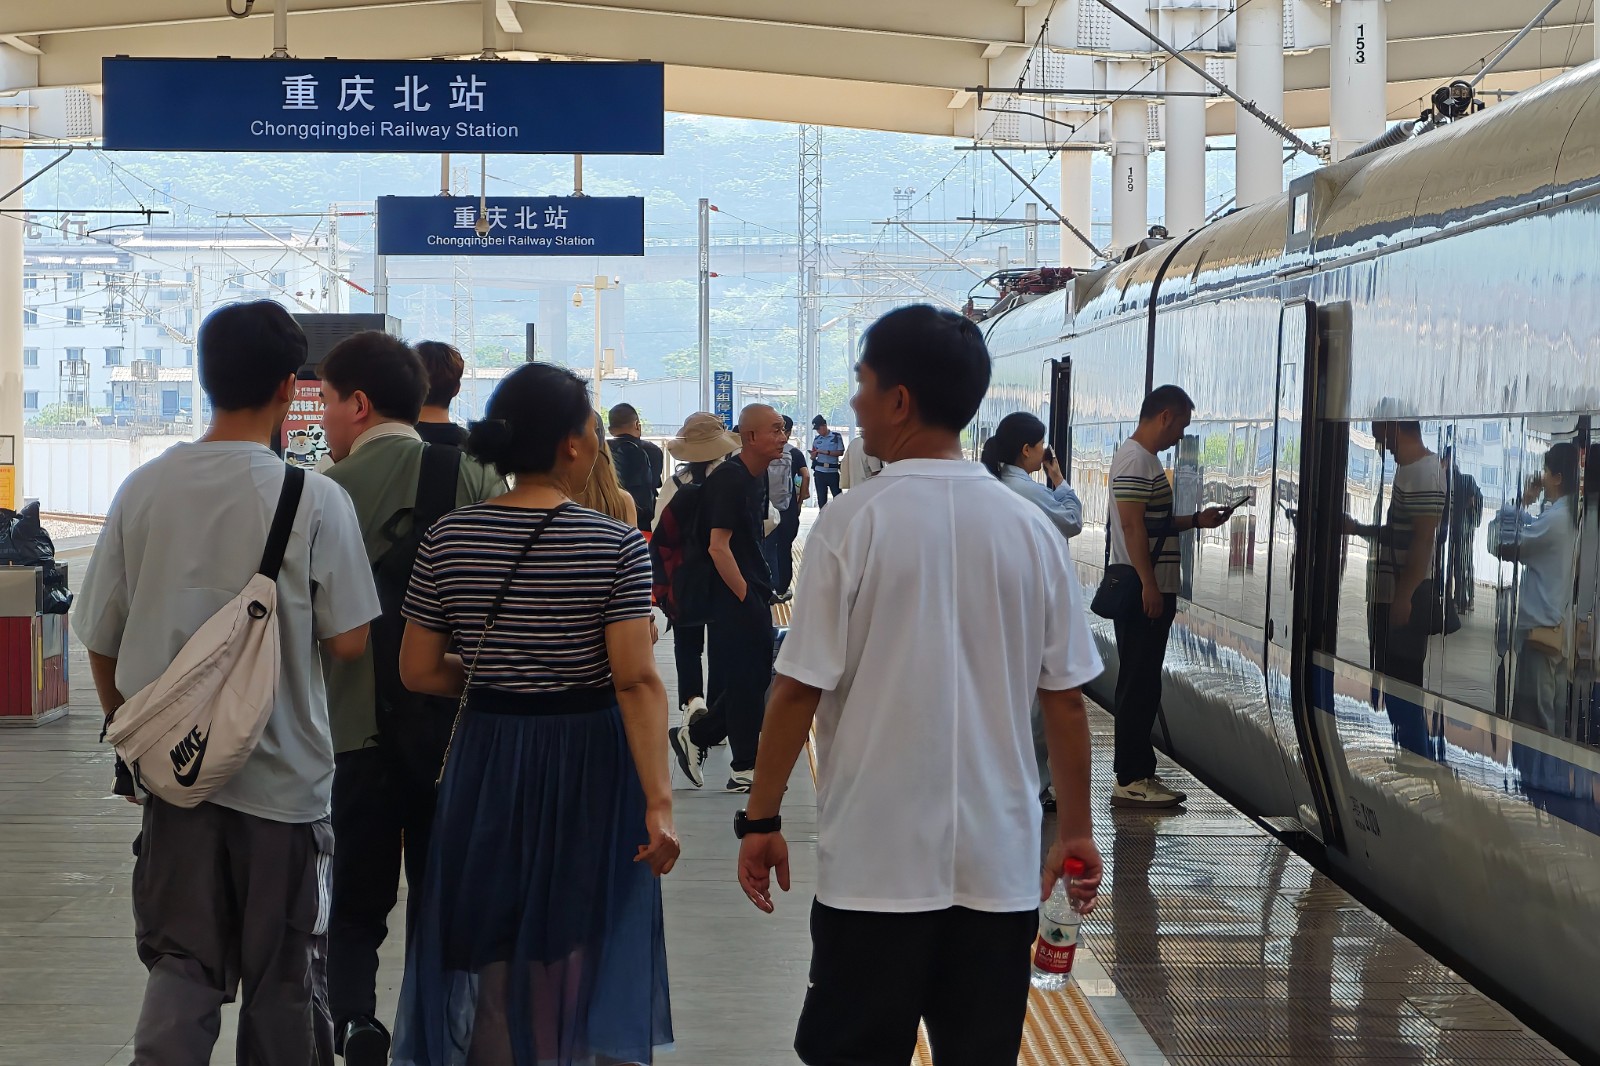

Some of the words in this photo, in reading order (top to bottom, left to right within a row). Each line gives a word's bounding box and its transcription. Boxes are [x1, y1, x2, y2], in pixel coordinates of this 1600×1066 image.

[1355, 24, 1365, 63] 153
[281, 74, 487, 112] 重庆北站
[250, 120, 375, 140] Chongqingbei
[380, 121, 451, 140] Railway
[455, 122, 519, 138] Station
[453, 205, 569, 230] 重庆北站
[427, 235, 505, 247] Chongqingbei
[508, 235, 551, 248] Railway
[554, 236, 595, 247] Station
[169, 724, 205, 773] NIKE
